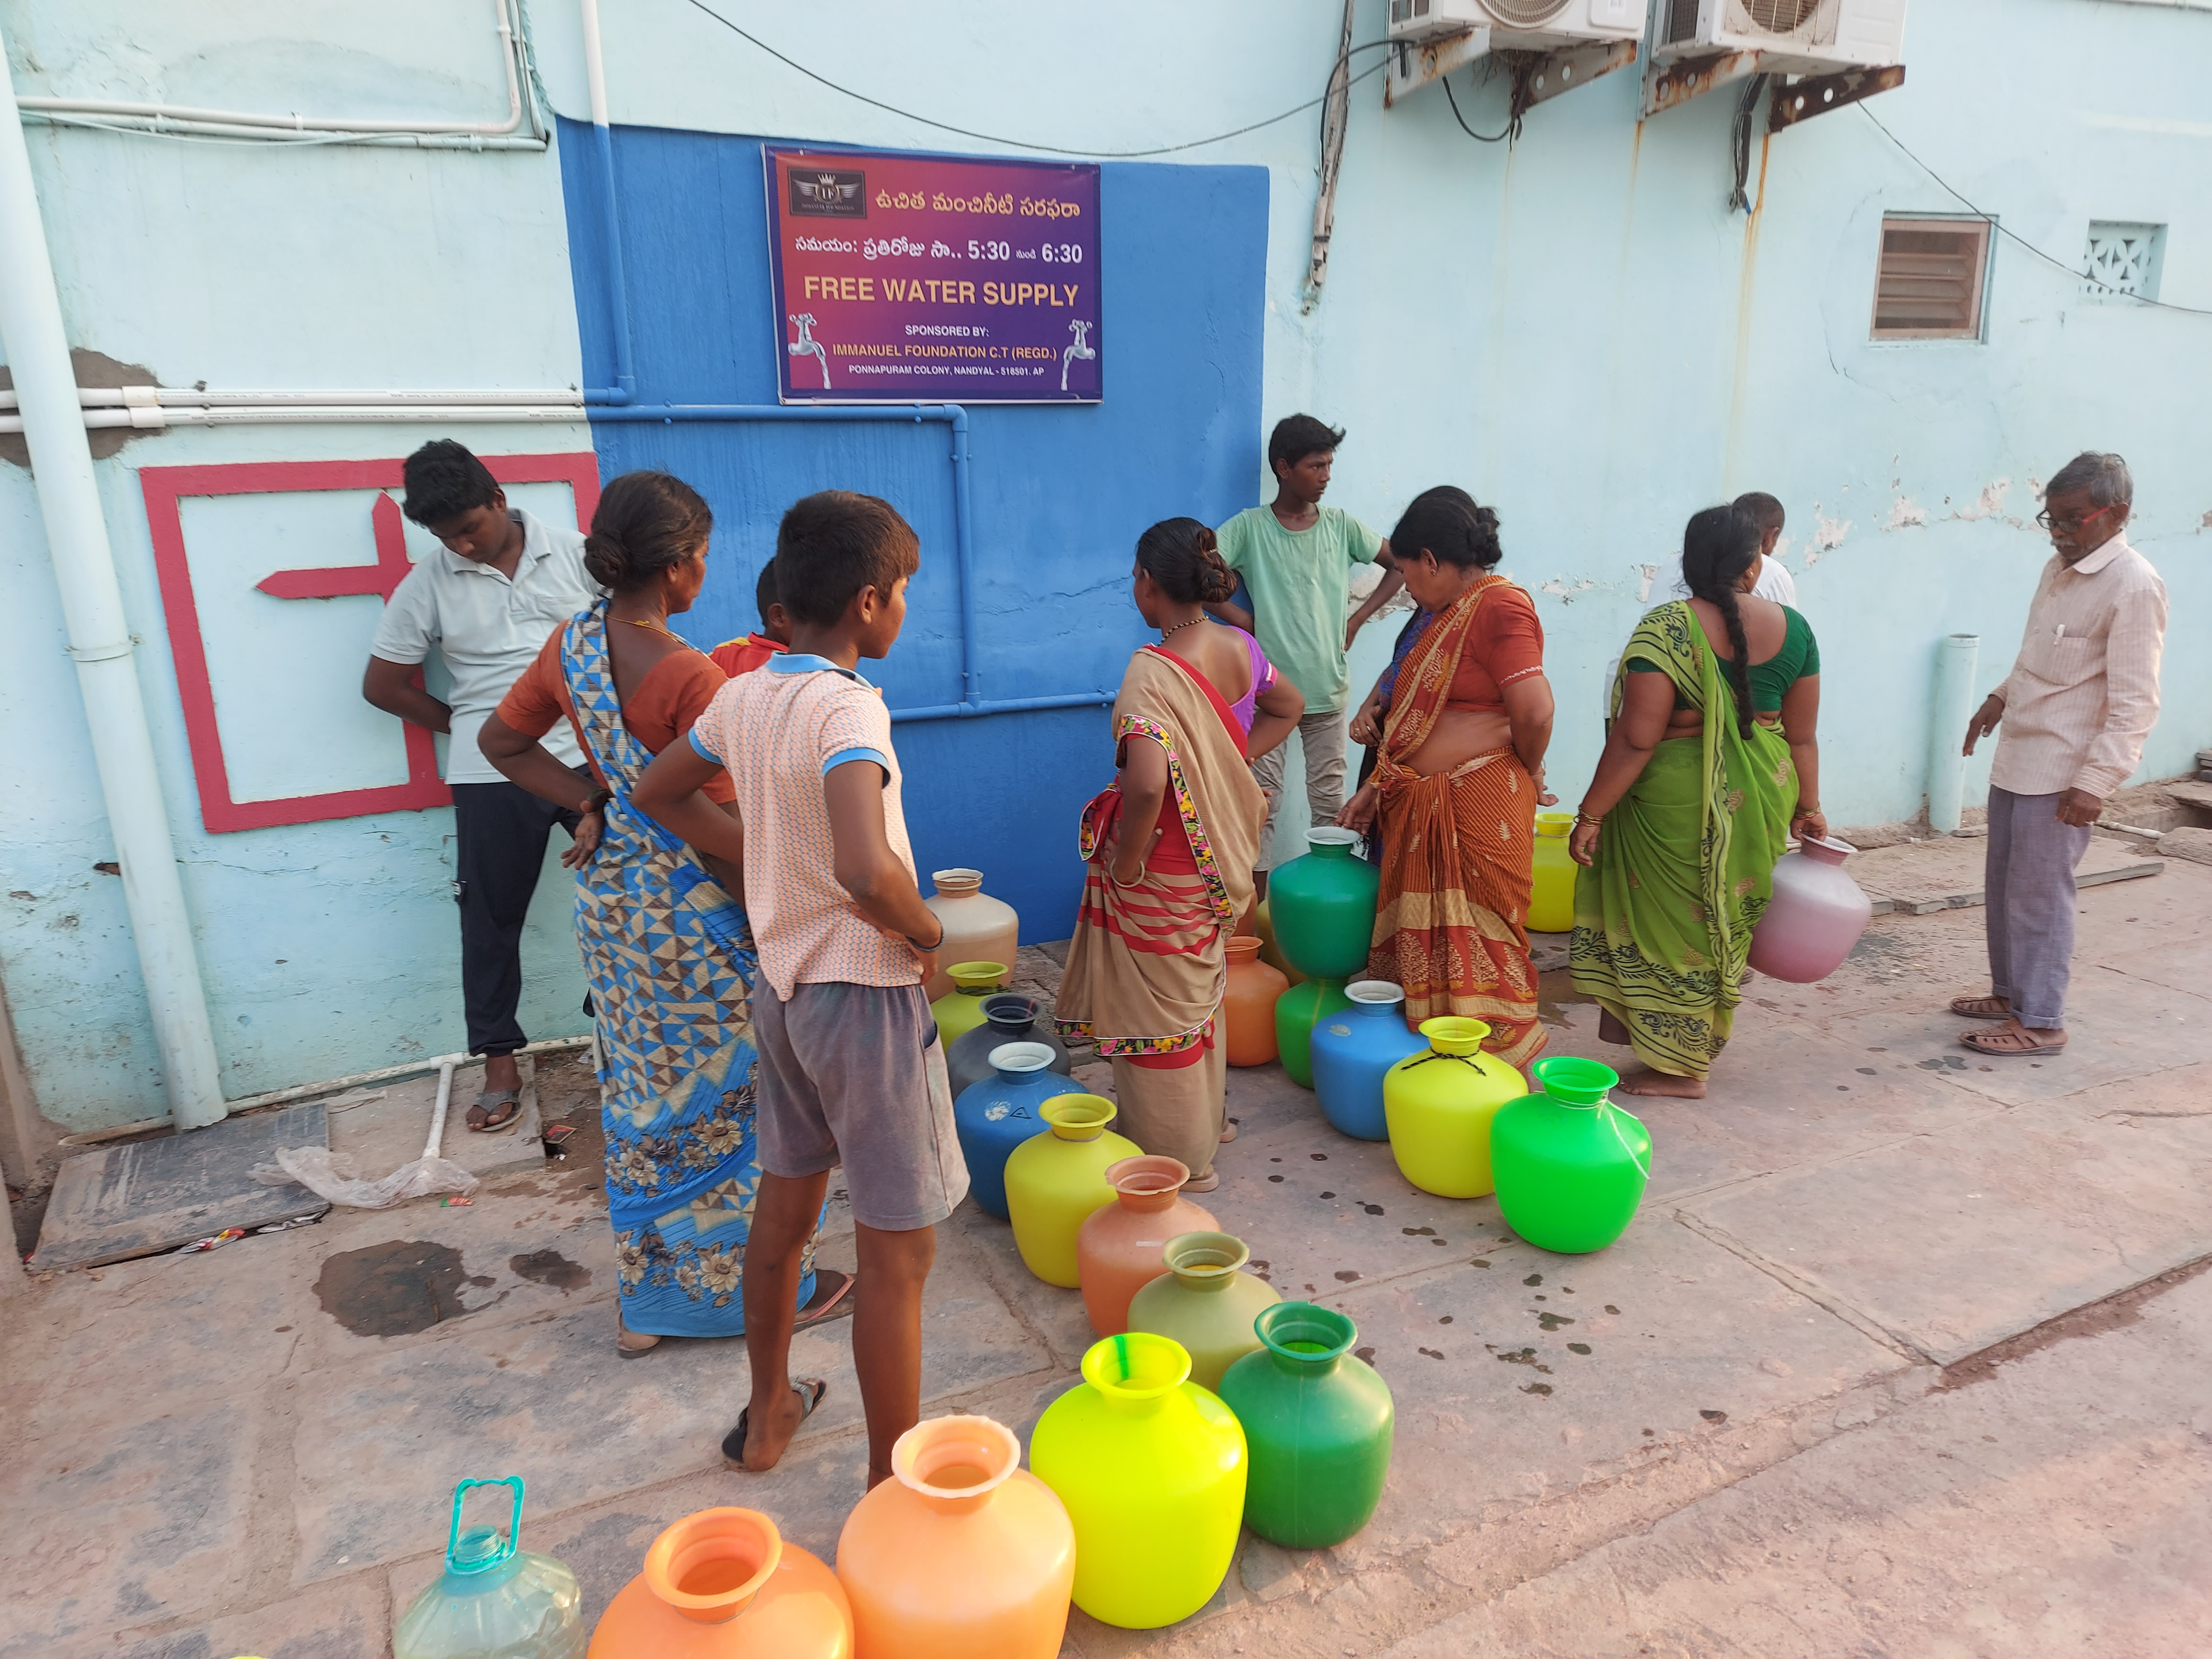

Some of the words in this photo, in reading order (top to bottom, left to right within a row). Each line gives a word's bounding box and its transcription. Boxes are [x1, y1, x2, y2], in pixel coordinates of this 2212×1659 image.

[968, 239, 1010, 261] 5:30
[1041, 243, 1083, 264] 6:30
[804, 276, 875, 301] FREE
[882, 277, 976, 304] WATER
[983, 281, 1079, 307] SUPPLY
[905, 324, 970, 336] SPONSORED
[973, 326, 989, 337] BY:
[832, 343, 902, 357] IMMANUEL
[905, 344, 986, 358] FOUNDATION
[989, 346, 1009, 359] C.T
[1012, 346, 1057, 362] (REGD.)
[849, 365, 912, 375] PONNAPURAM
[954, 365, 995, 376] NANDYAL
[1033, 367, 1045, 376] AP
